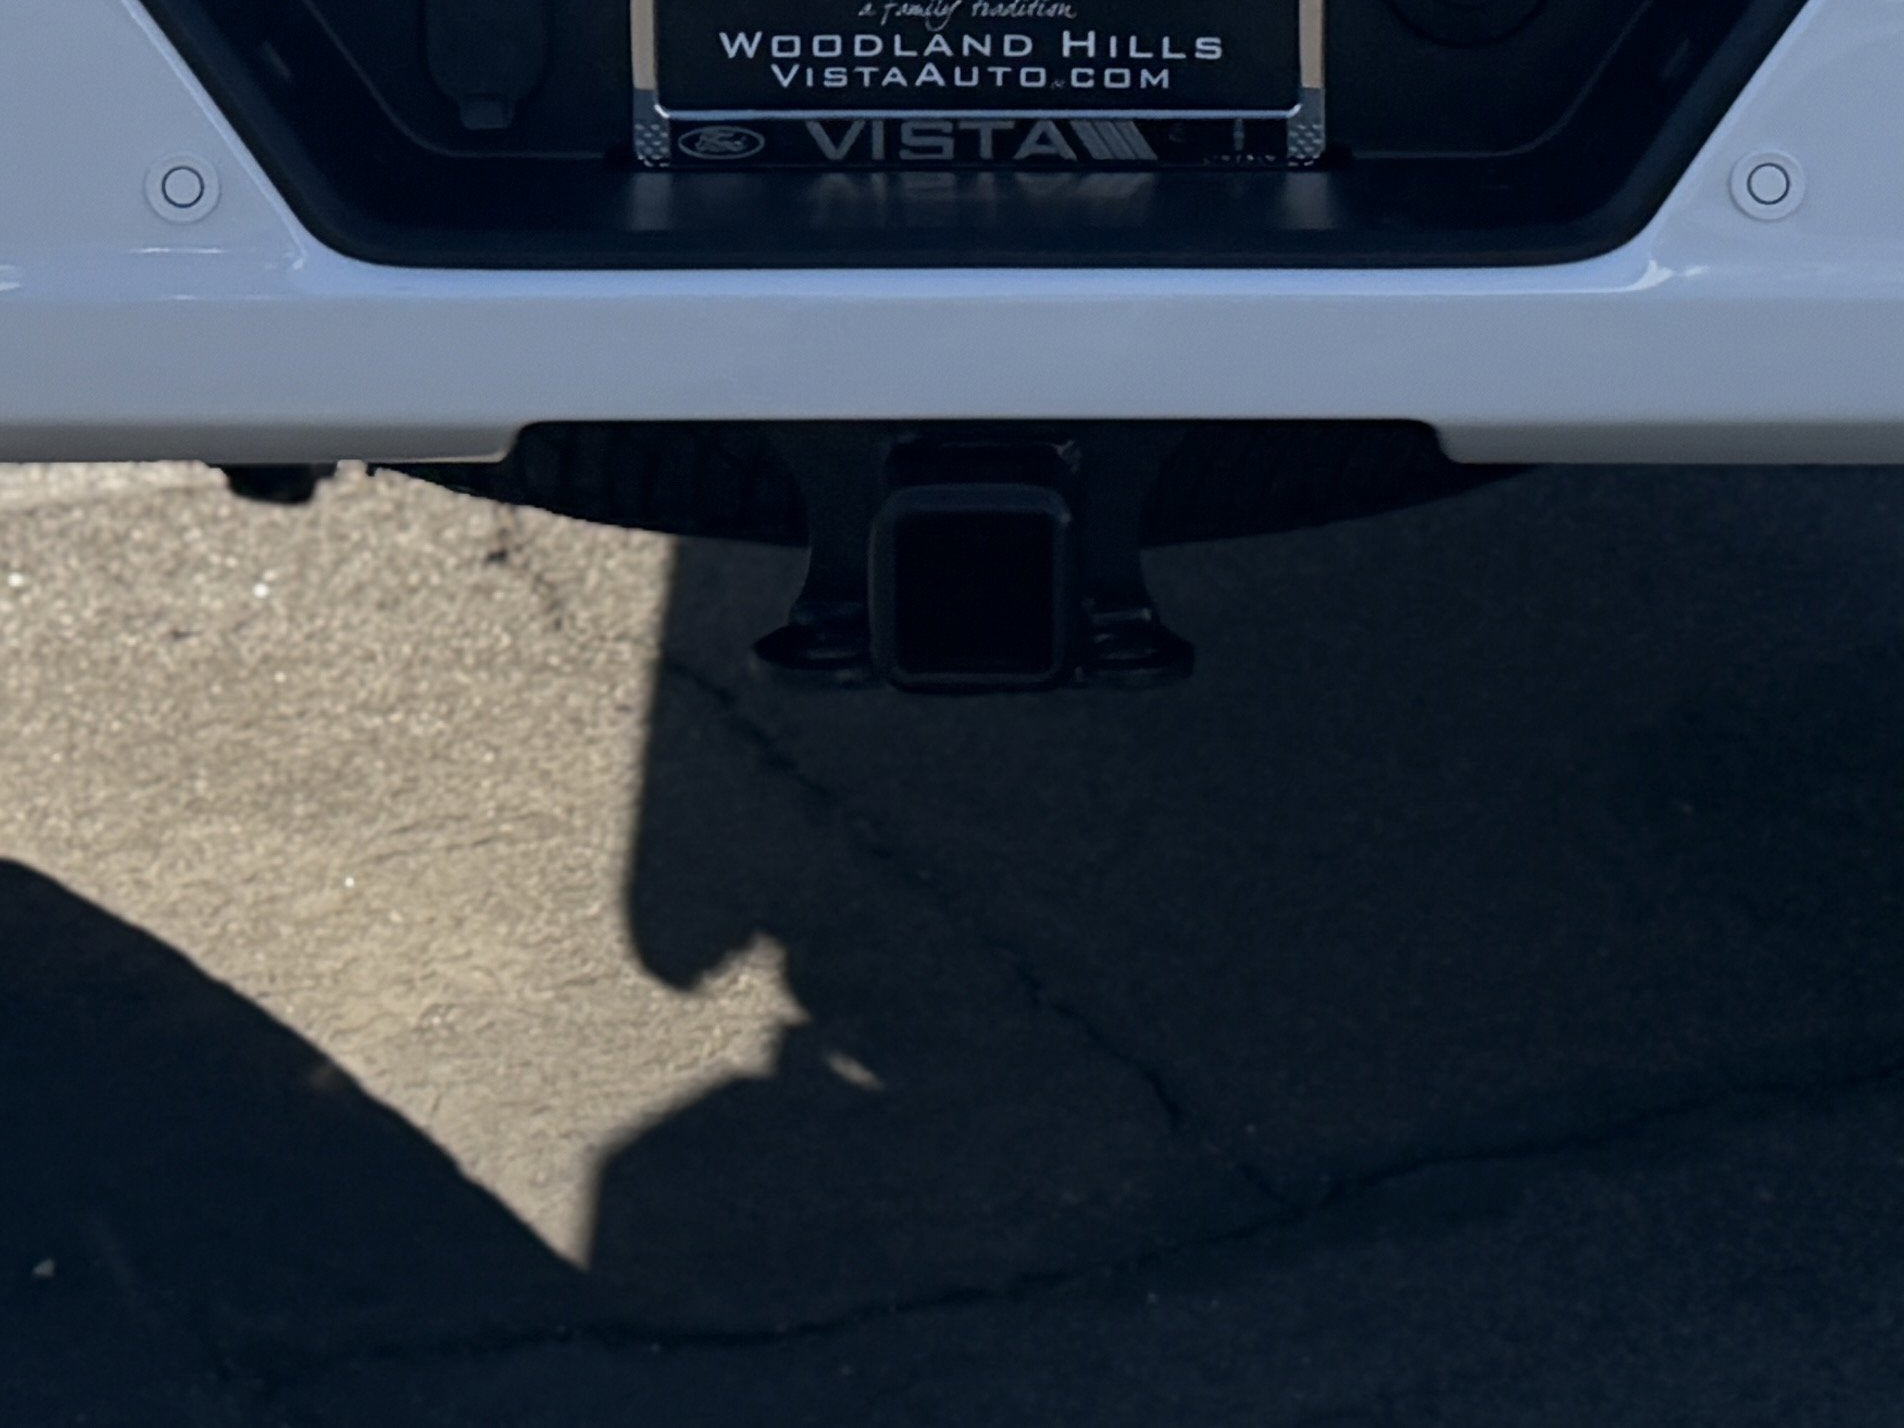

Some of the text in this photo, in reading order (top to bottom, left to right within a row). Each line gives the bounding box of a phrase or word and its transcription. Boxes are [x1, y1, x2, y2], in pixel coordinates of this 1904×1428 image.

[718, 29, 1223, 60] WOODLAND HILLS
[770, 62, 1171, 89] VISTAAUTO.COM
[803, 119, 1078, 161] VISTA
